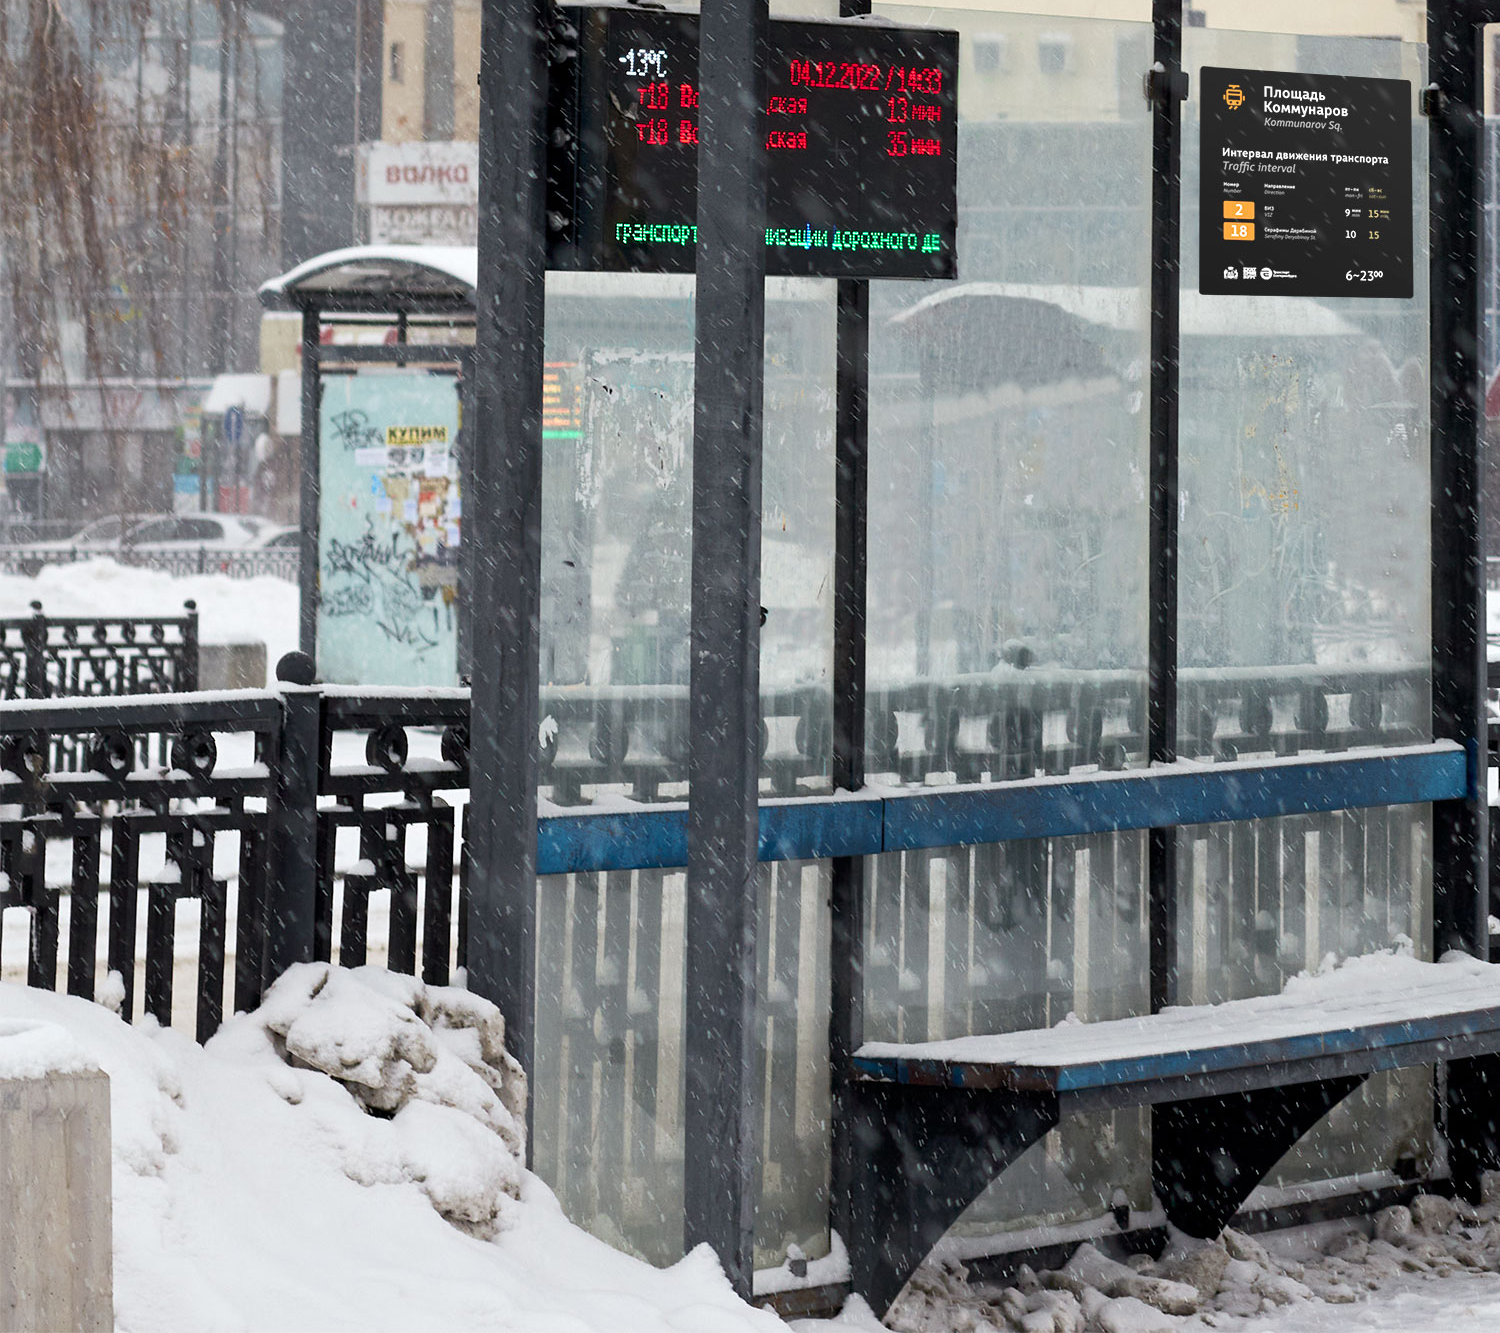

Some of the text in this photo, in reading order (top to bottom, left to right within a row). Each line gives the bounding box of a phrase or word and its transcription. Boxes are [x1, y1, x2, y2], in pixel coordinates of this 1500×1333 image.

[790, 59, 880, 91] 04.12.2022
[898, 66, 943, 95] 14:33
[1264, 86, 1325, 102] Площадь
[886, 97, 908, 123] 13
[911, 105, 942, 122] мин
[1264, 101, 1348, 118] Коммунаров
[1264, 117, 1342, 132] Kommunarov Sq.
[887, 131, 908, 157] 35
[911, 139, 942, 156] мин
[1223, 147, 1388, 165] Интервал движения транспорта
[1222, 161, 1296, 174] Traffic interval
[1235, 204, 1243, 216] 2
[1369, 210, 1379, 218] 15
[1231, 225, 1379, 239] 18 10 15
